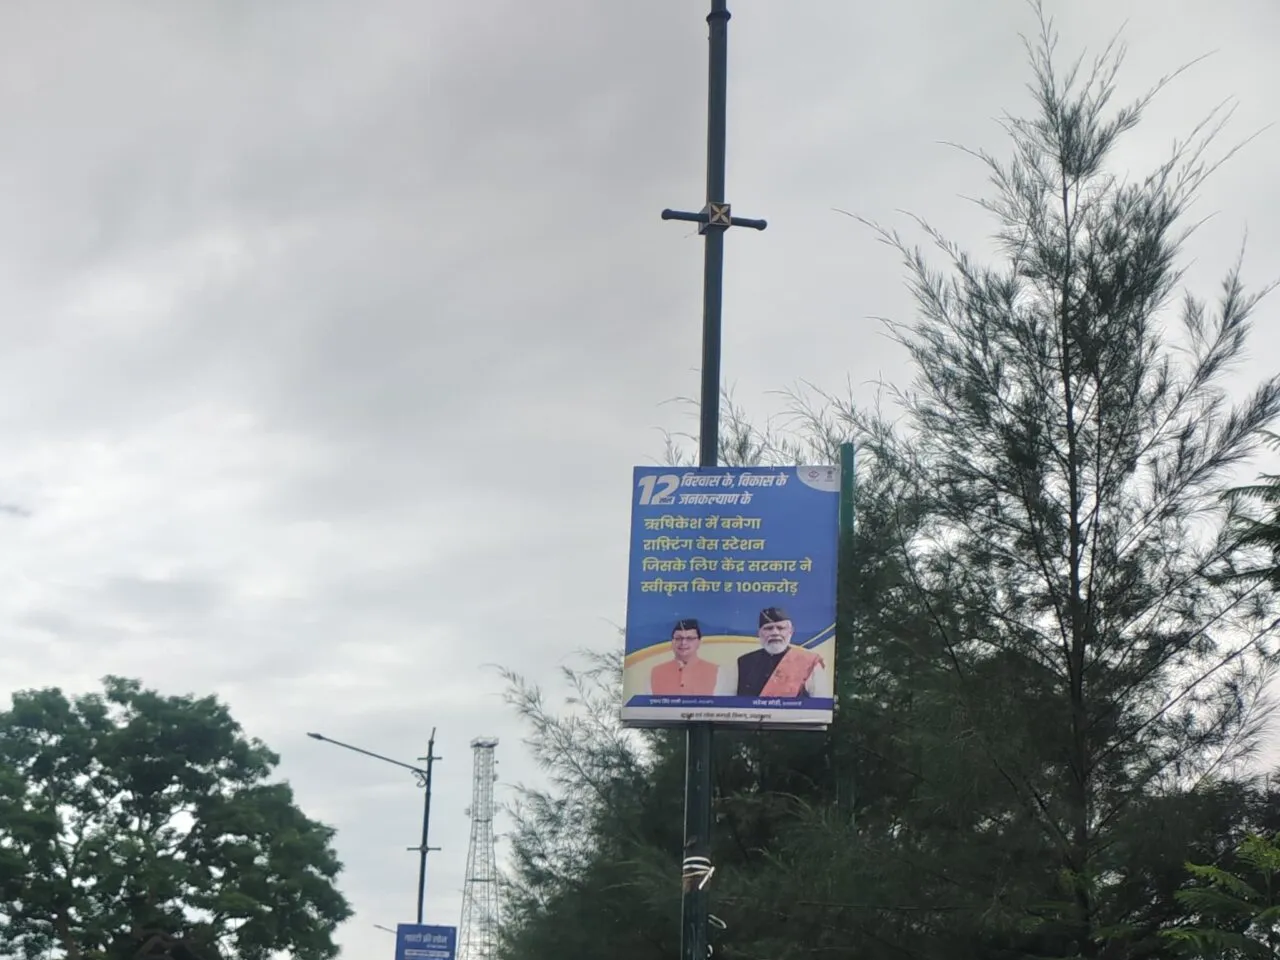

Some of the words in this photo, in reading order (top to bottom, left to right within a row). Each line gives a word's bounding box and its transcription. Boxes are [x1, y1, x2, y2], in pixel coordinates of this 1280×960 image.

[638, 475, 679, 505] 12
[776, 472, 789, 487] के
[741, 491, 754, 504] के
[644, 515, 702, 530] ऋषिकेश
[705, 515, 720, 529] में
[721, 516, 761, 529] बनेगा
[722, 536, 765, 550] स्टेशन
[643, 557, 686, 572] जिसके
[690, 557, 717, 571] लिए
[748, 560, 796, 571] सरकार
[800, 557, 812, 571] ने
[641, 578, 688, 596] स्वीकृत
[691, 578, 720, 592] किए
